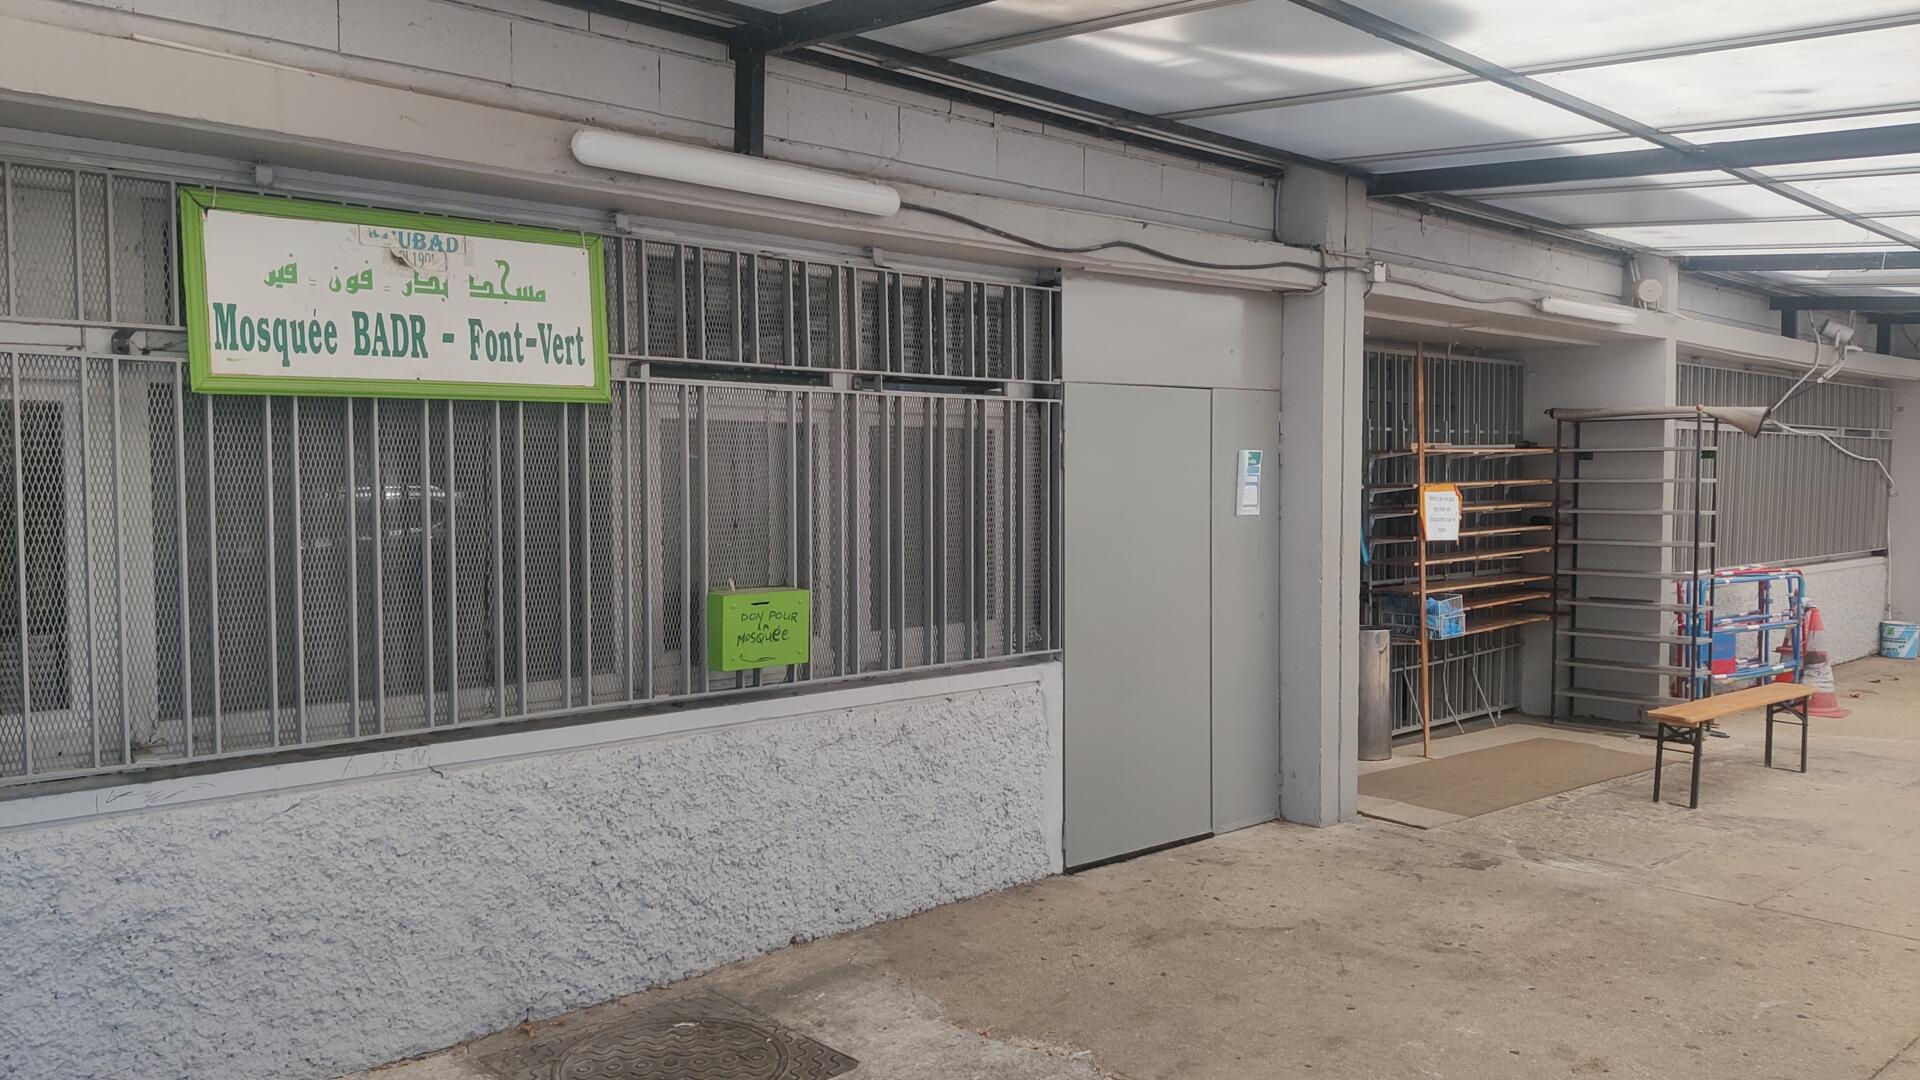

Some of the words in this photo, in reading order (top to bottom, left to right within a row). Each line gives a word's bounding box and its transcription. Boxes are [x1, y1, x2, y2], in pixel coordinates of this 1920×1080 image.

[213, 302, 338, 367] Mosquée
[352, 310, 429, 359] BADR
[468, 318, 586, 366] Font-Vert
[741, 610, 764, 622] DON
[769, 611, 798, 623] POUR
